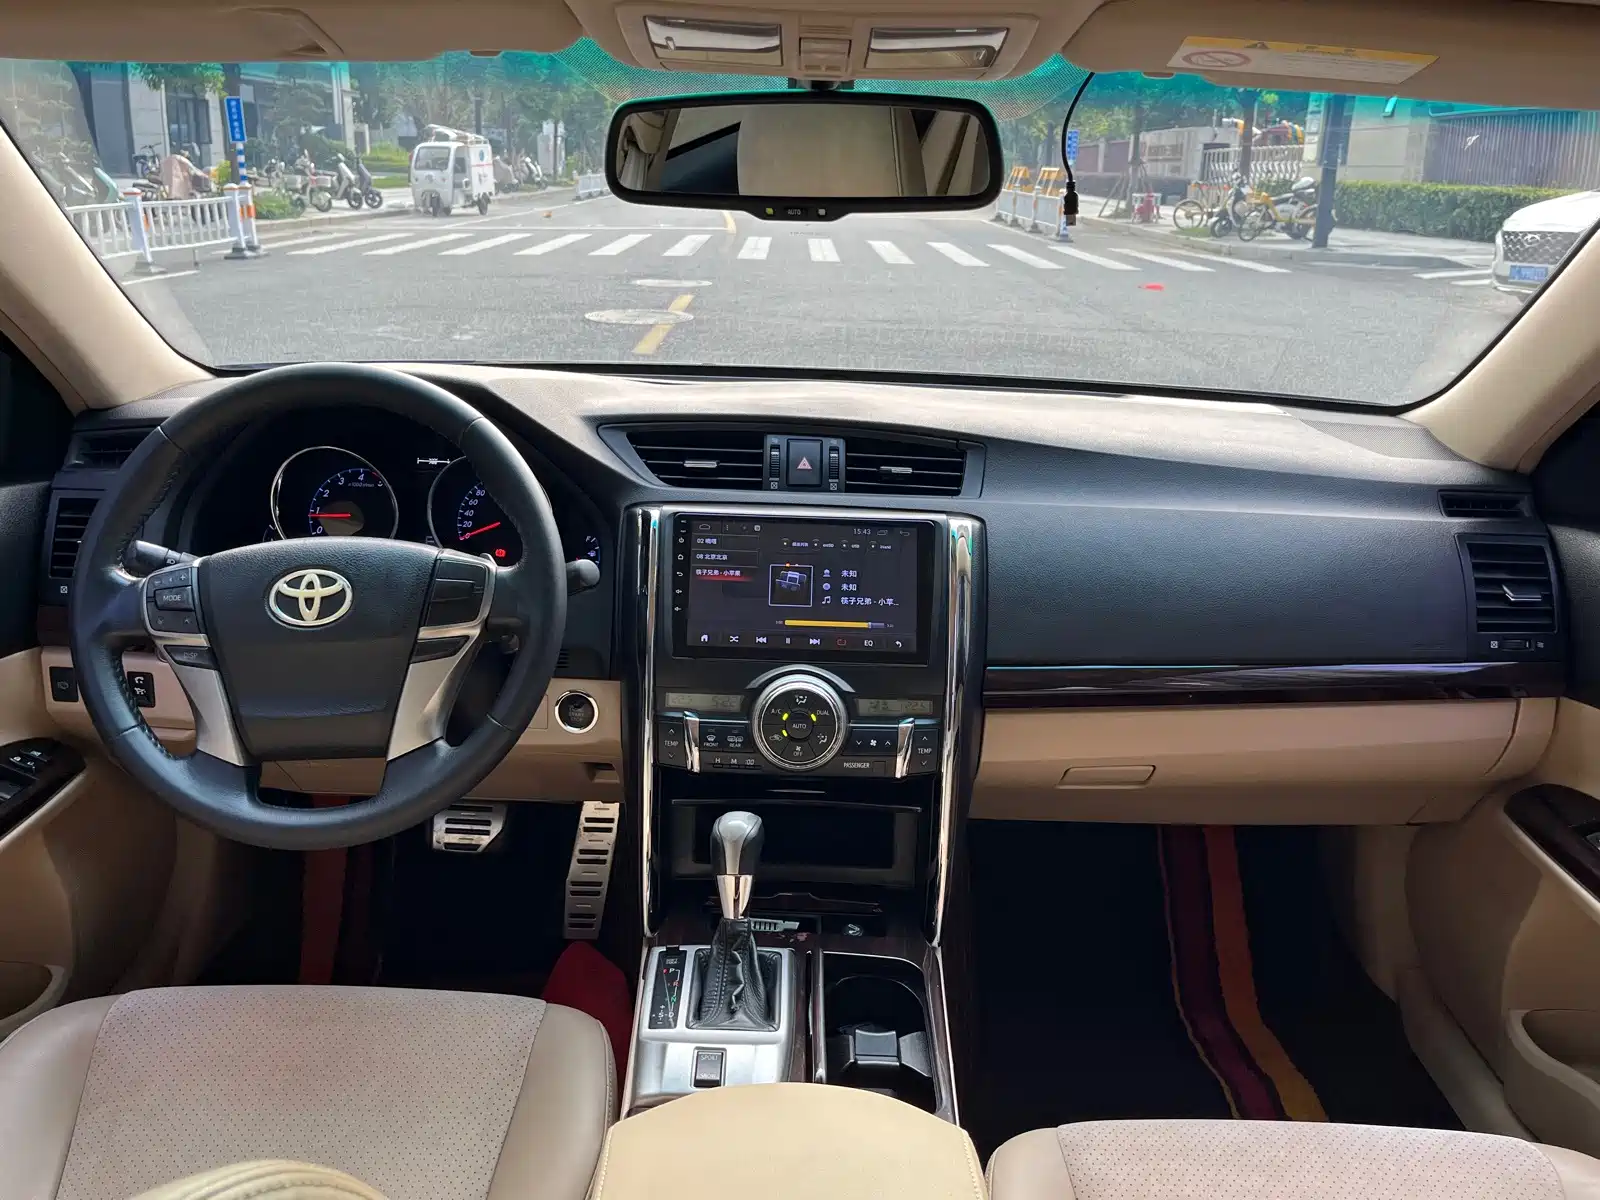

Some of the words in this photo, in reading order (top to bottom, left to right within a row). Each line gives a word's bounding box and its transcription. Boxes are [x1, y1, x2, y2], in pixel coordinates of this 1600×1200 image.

[787, 208, 802, 216] AUTO
[338, 477, 345, 485] 3
[357, 473, 365, 481] 4
[323, 489, 330, 497] 2
[468, 498, 479, 506] 60
[316, 506, 320, 514] 1
[464, 509, 474, 517] 40
[462, 520, 473, 528] 20
[316, 526, 323, 534] 0
[853, 528, 871, 536] 15:43
[841, 569, 857, 578] 未知
[841, 583, 857, 592] 未知
[163, 594, 181, 602] MODE
[864, 639, 874, 647] EQ
[792, 722, 807, 730] AUTO
